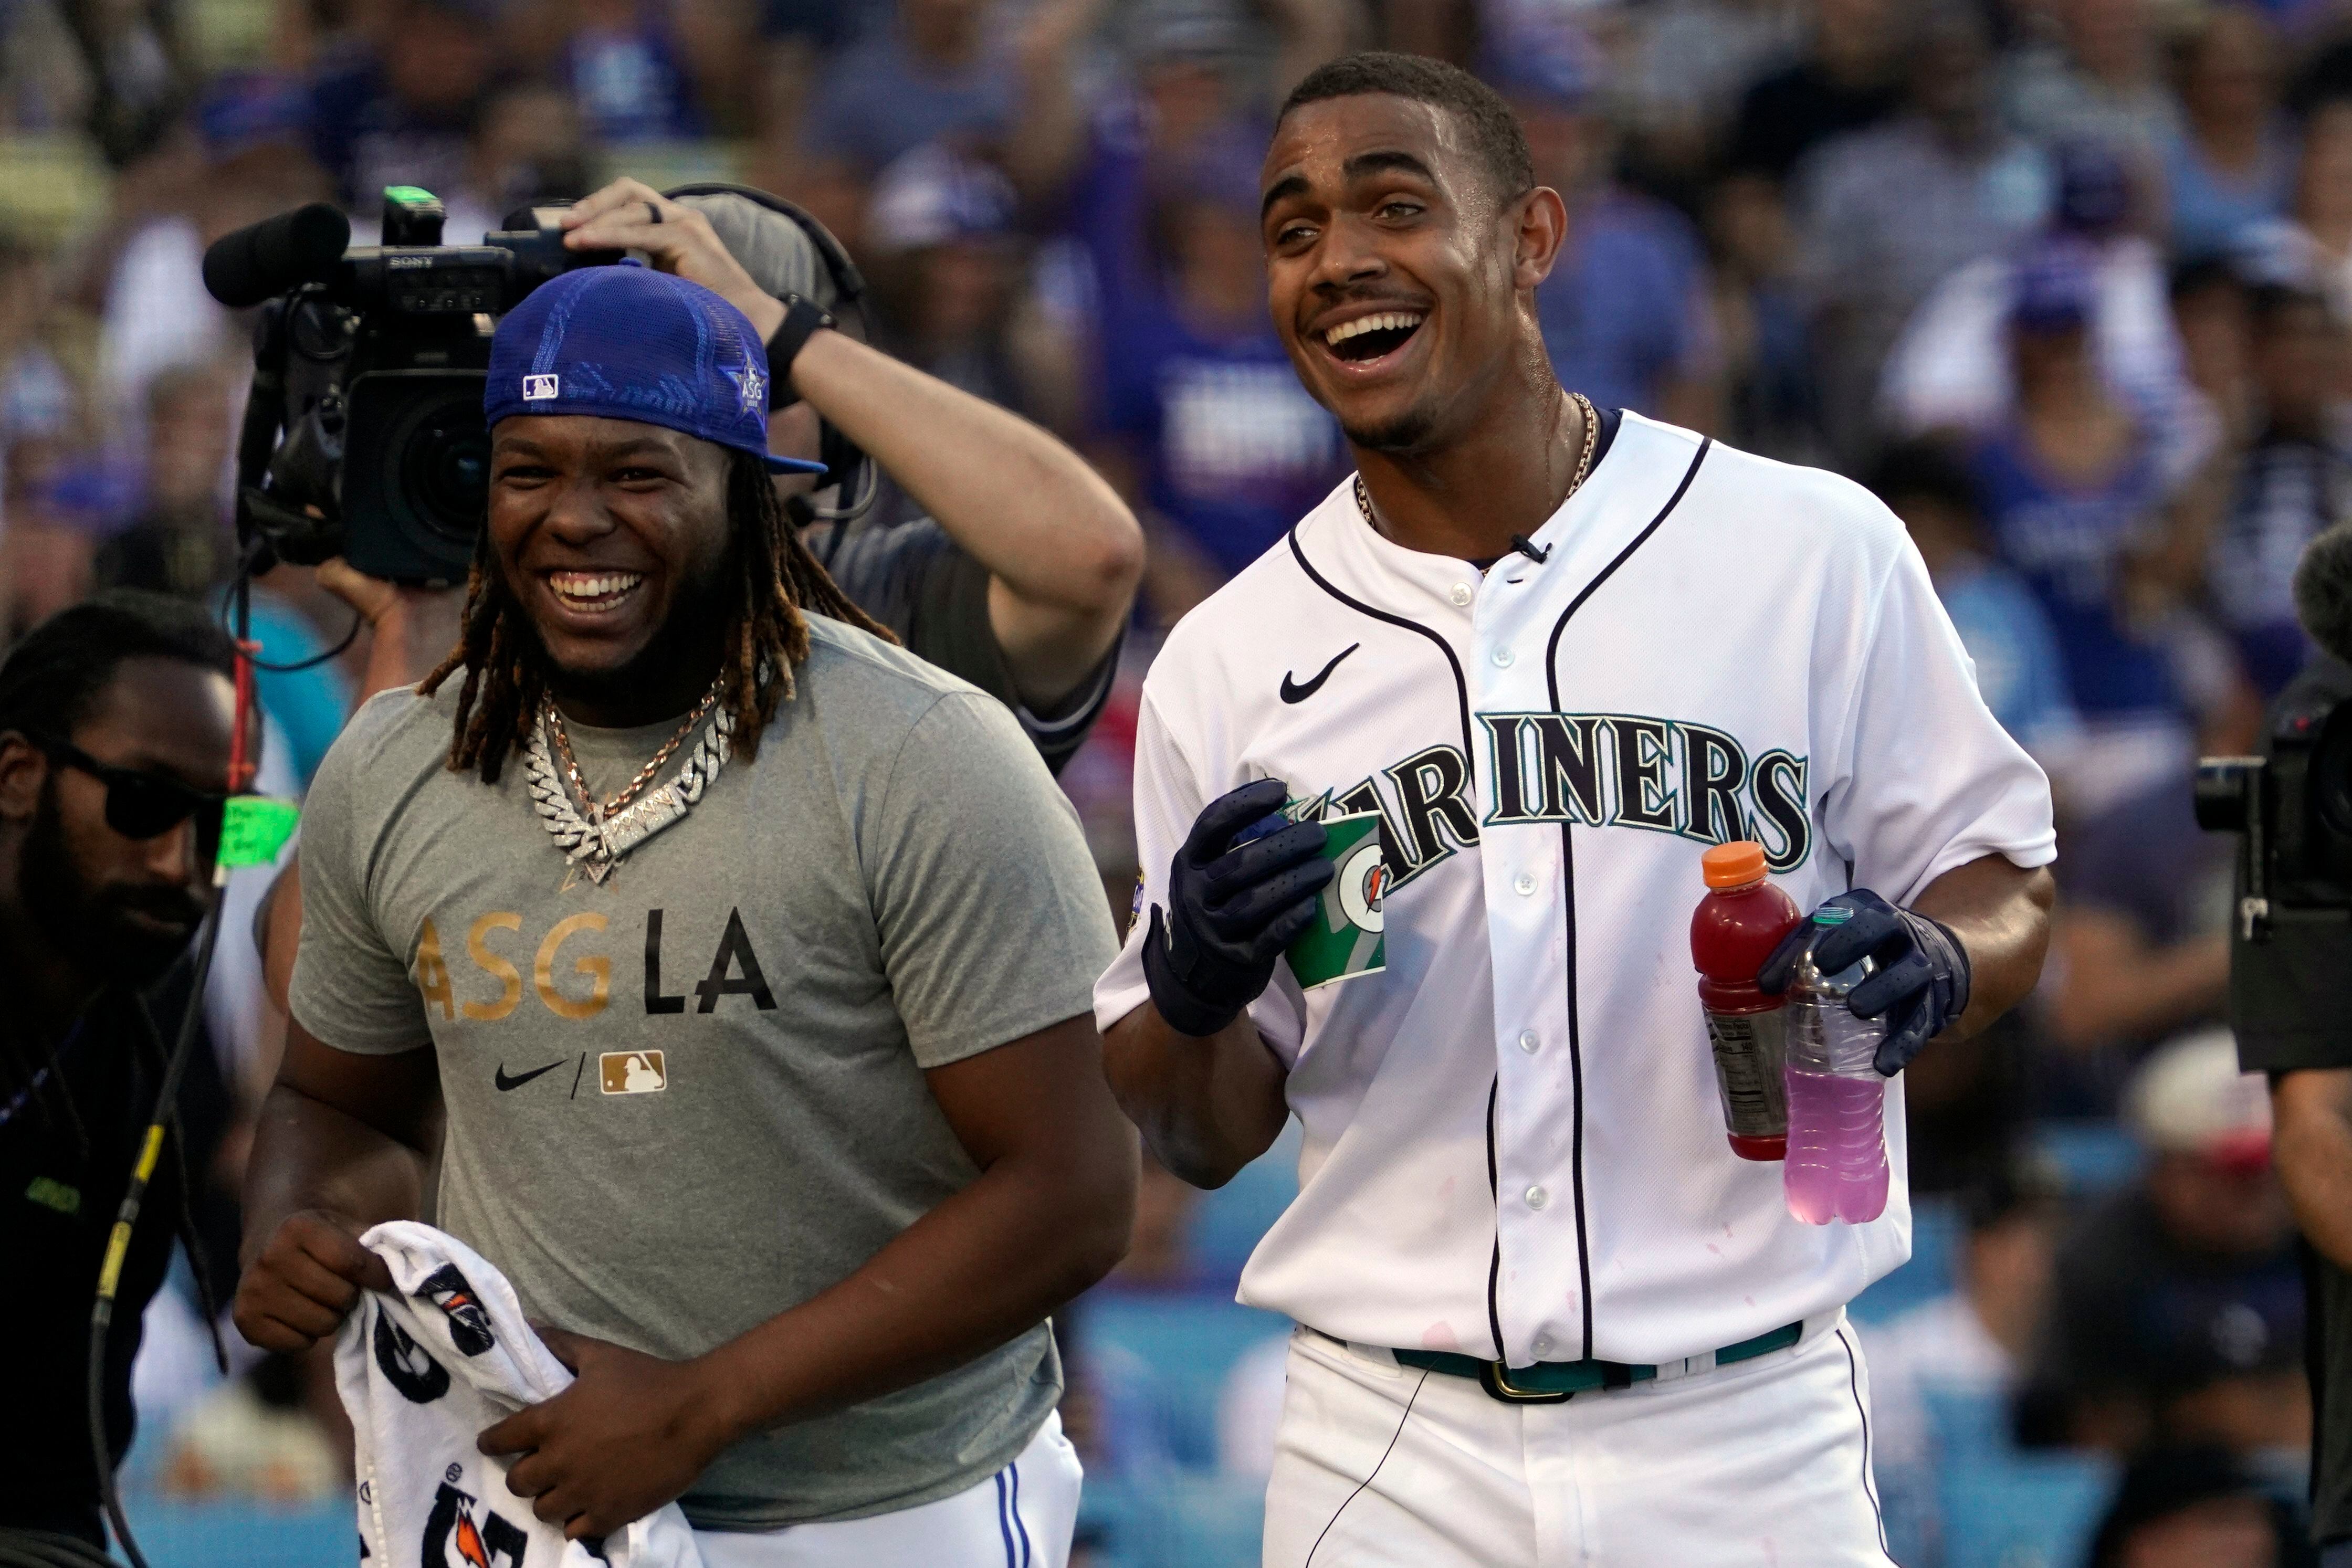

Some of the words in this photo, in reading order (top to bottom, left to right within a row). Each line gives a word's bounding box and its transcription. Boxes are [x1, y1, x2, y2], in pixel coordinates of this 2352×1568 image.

[390, 256, 433, 269] SONY
[742, 381, 762, 400] ASG
[1285, 711, 1813, 896] ARINERS
[417, 911, 612, 1022] ASG
[644, 906, 778, 1014] LA
